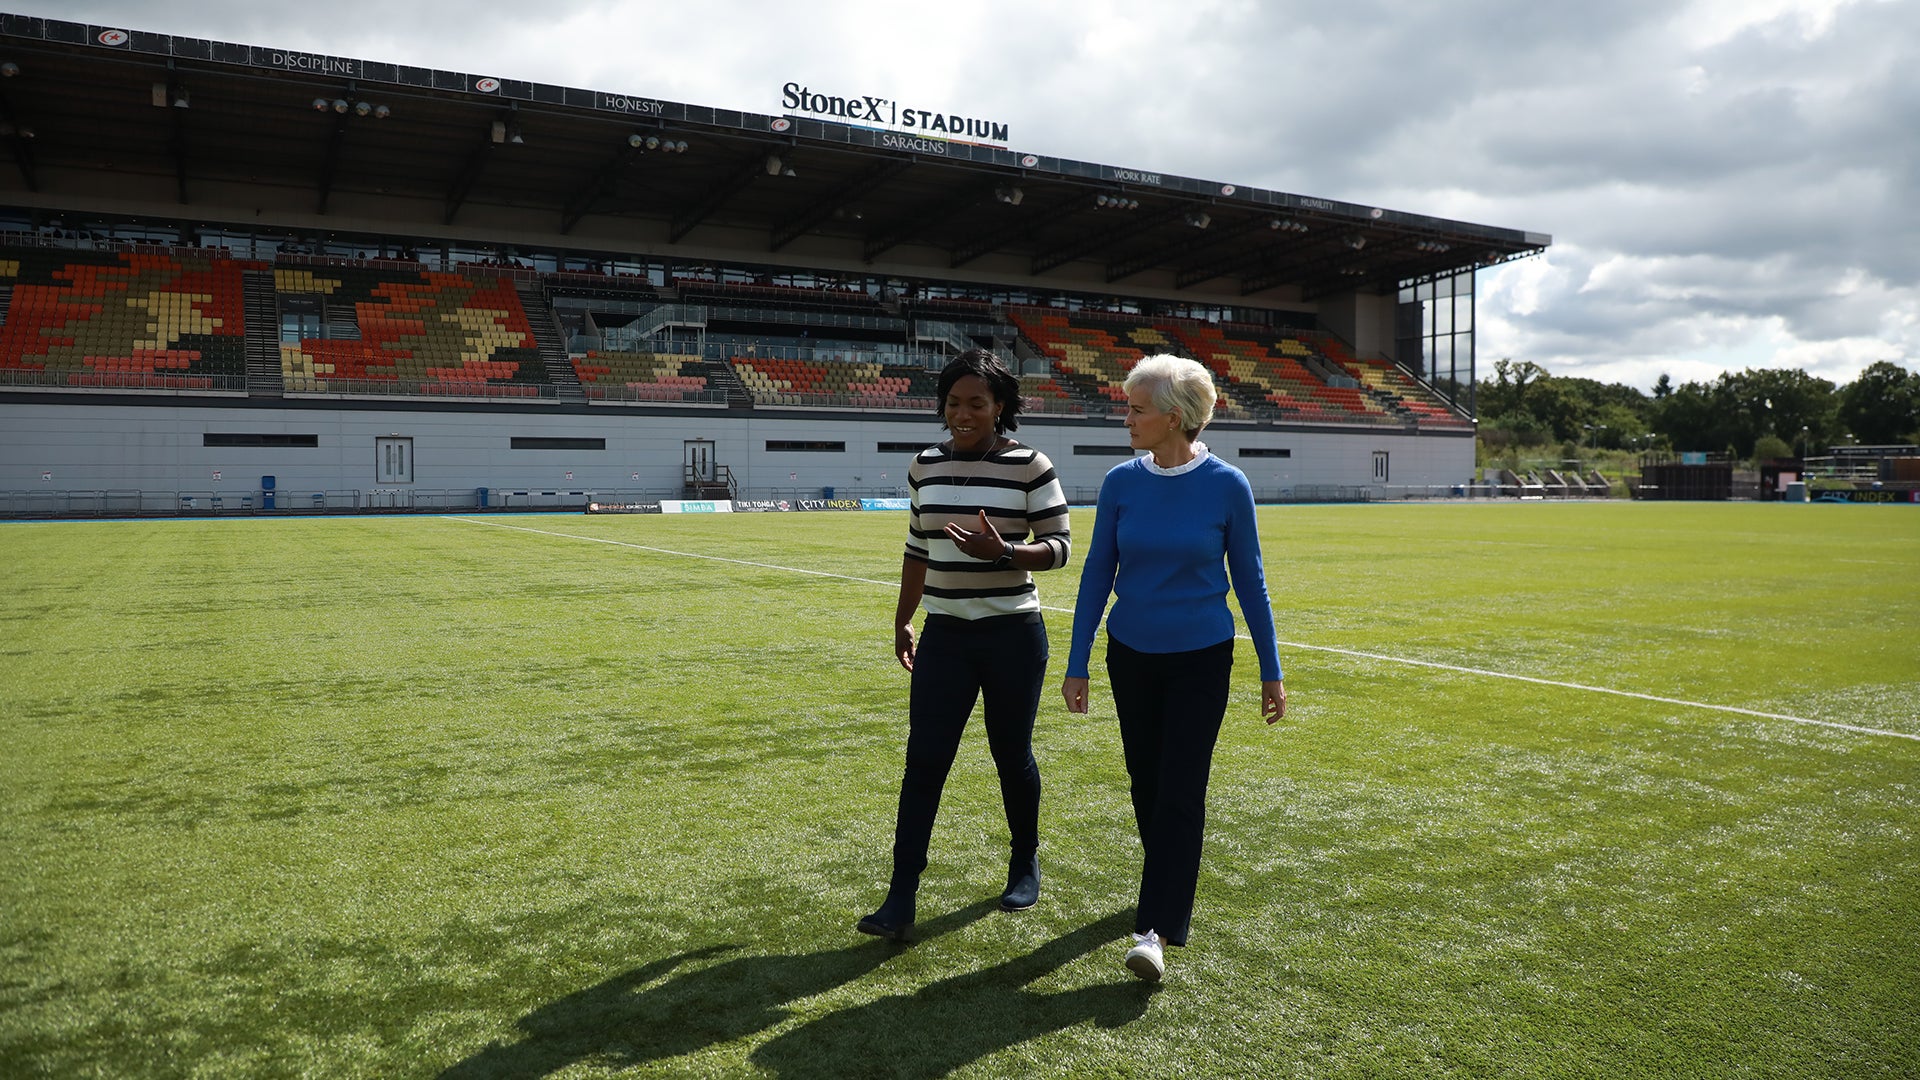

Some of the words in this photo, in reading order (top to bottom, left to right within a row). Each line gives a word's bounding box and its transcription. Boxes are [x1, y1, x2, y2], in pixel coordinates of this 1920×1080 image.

[272, 53, 354, 74] DISCIPLINE
[605, 96, 664, 114] HONESTY
[782, 82, 884, 122] StoneX
[902, 108, 1008, 141] STADIUM
[883, 134, 945, 154] SARACENS
[1113, 169, 1140, 181] WORK
[1141, 173, 1161, 185] RATE
[803, 500, 825, 508] CITY
[828, 500, 859, 508] INDEX
[1822, 491, 1851, 500] CITY
[1854, 491, 1896, 501] INDEX
[685, 502, 713, 512] SIMBA
